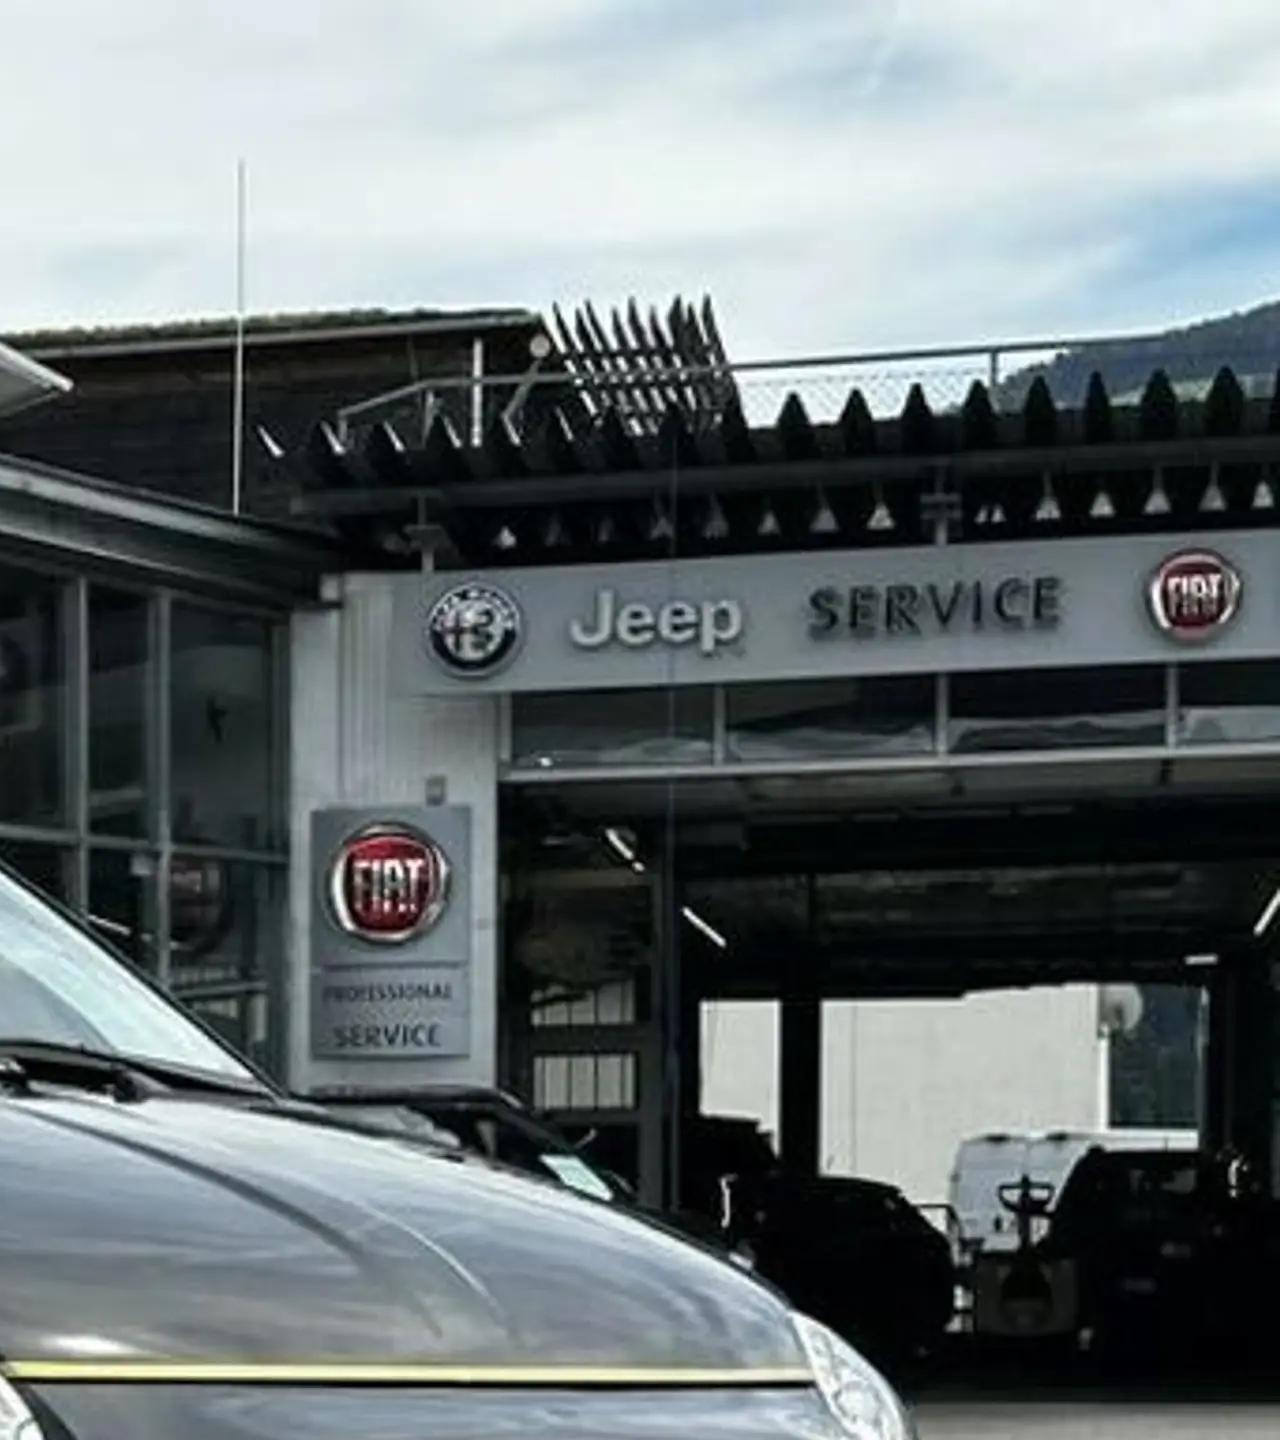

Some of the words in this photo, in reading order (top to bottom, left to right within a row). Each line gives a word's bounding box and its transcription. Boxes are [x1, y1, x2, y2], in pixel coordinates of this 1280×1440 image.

[570, 589, 742, 651] Jeep
[808, 577, 1063, 634] SERVICE
[1167, 573, 1221, 617] FIAT
[352, 858, 425, 912] FIAT
[333, 1024, 442, 1047] SERVICE
